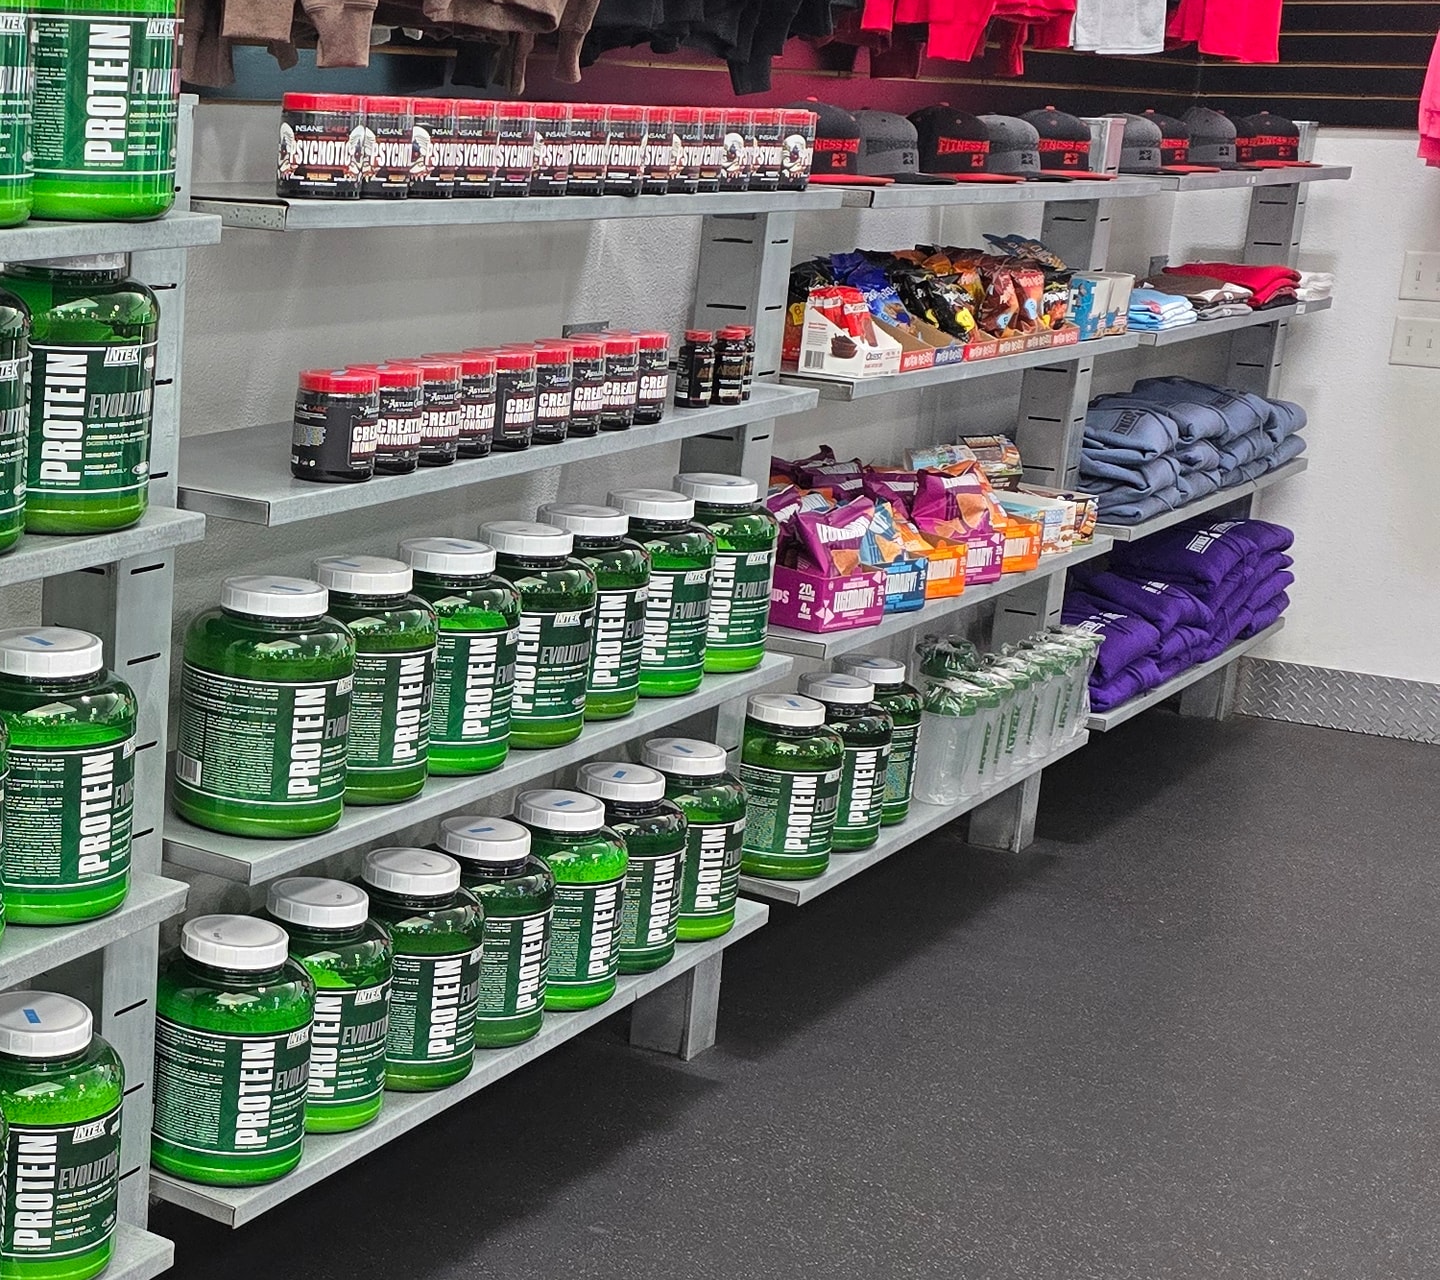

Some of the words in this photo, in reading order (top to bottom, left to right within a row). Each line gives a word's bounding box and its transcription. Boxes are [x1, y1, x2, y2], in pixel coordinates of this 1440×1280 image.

[84, 24, 132, 166] PROTEIN
[295, 125, 324, 133] INSANE
[290, 140, 352, 166] PSYCHOTIC
[104, 346, 140, 367] INTEK
[40, 353, 88, 481] PROTEIN
[592, 594, 627, 686] PROTEIN
[393, 656, 425, 763] PROTEIN
[461, 637, 498, 738] PROTEIN
[287, 688, 326, 798] PROTEIN
[849, 751, 876, 825] PROTEIN
[78, 752, 114, 875] PROTEIN
[784, 776, 817, 852] PROTEIN
[647, 857, 676, 945] PROTEIN
[694, 828, 727, 910] PROTEIN
[516, 917, 545, 1011] PROTEIN
[588, 887, 617, 976] PROTEIN
[427, 959, 462, 1057] PROTEIN
[73, 1120, 107, 1144] INTEK
[235, 1042, 275, 1148] PROTEIN
[13, 1135, 57, 1248] PROTEIN
